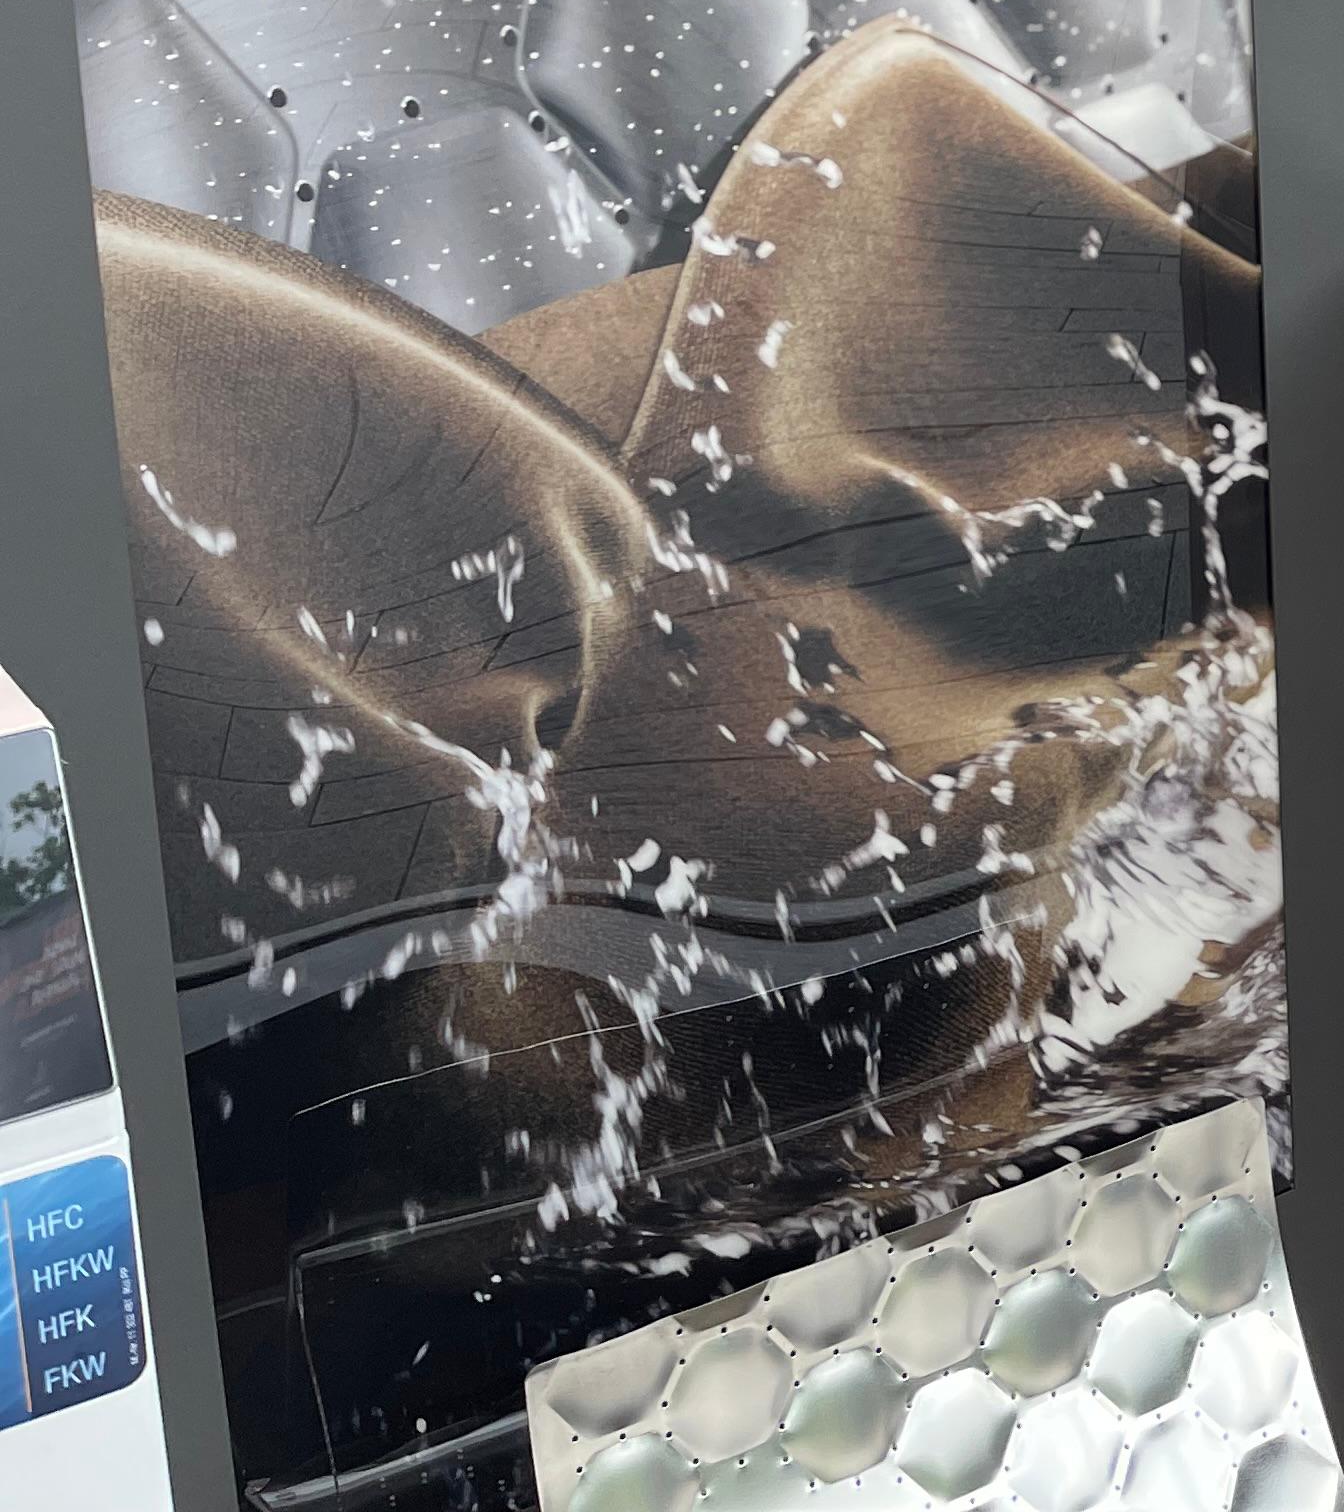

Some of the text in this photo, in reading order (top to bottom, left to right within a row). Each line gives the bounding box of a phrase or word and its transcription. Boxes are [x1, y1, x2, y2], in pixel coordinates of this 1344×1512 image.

[26, 1203, 85, 1243] HFC
[32, 1244, 115, 1294] HFKW
[38, 1303, 97, 1345] HFK
[43, 1350, 107, 1394] FKW
